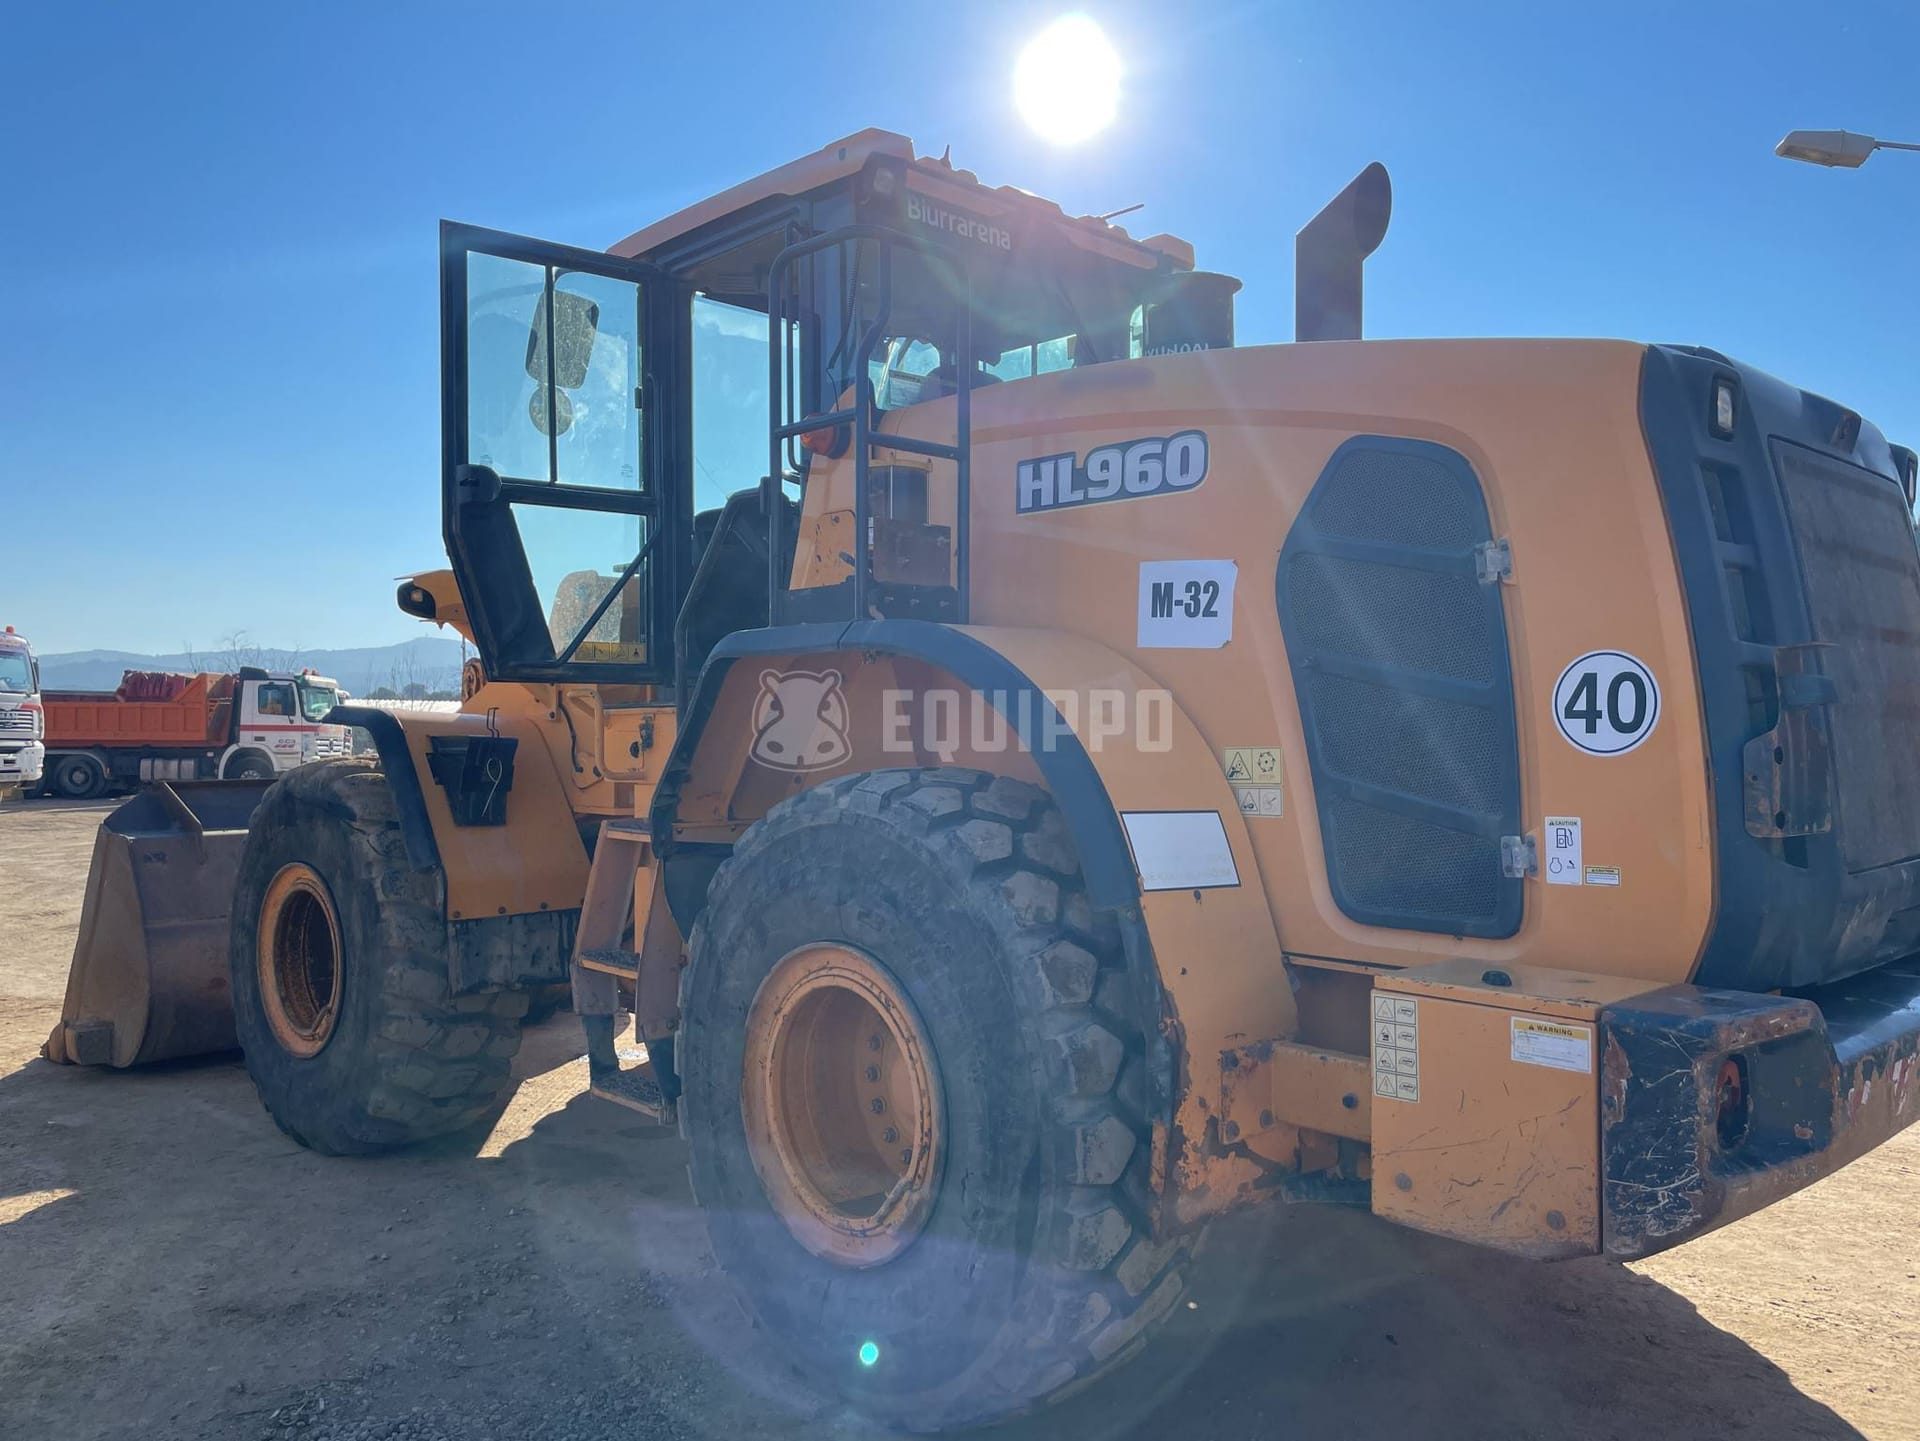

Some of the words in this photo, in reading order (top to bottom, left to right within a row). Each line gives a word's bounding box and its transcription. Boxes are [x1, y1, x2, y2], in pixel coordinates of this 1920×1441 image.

[1143, 342, 1209, 357] YUNDAI
[1019, 433, 1206, 510] HL960
[1151, 580, 1220, 619] M-32
[1564, 671, 1647, 735] 40
[1536, 1024, 1573, 1036] WARNING
